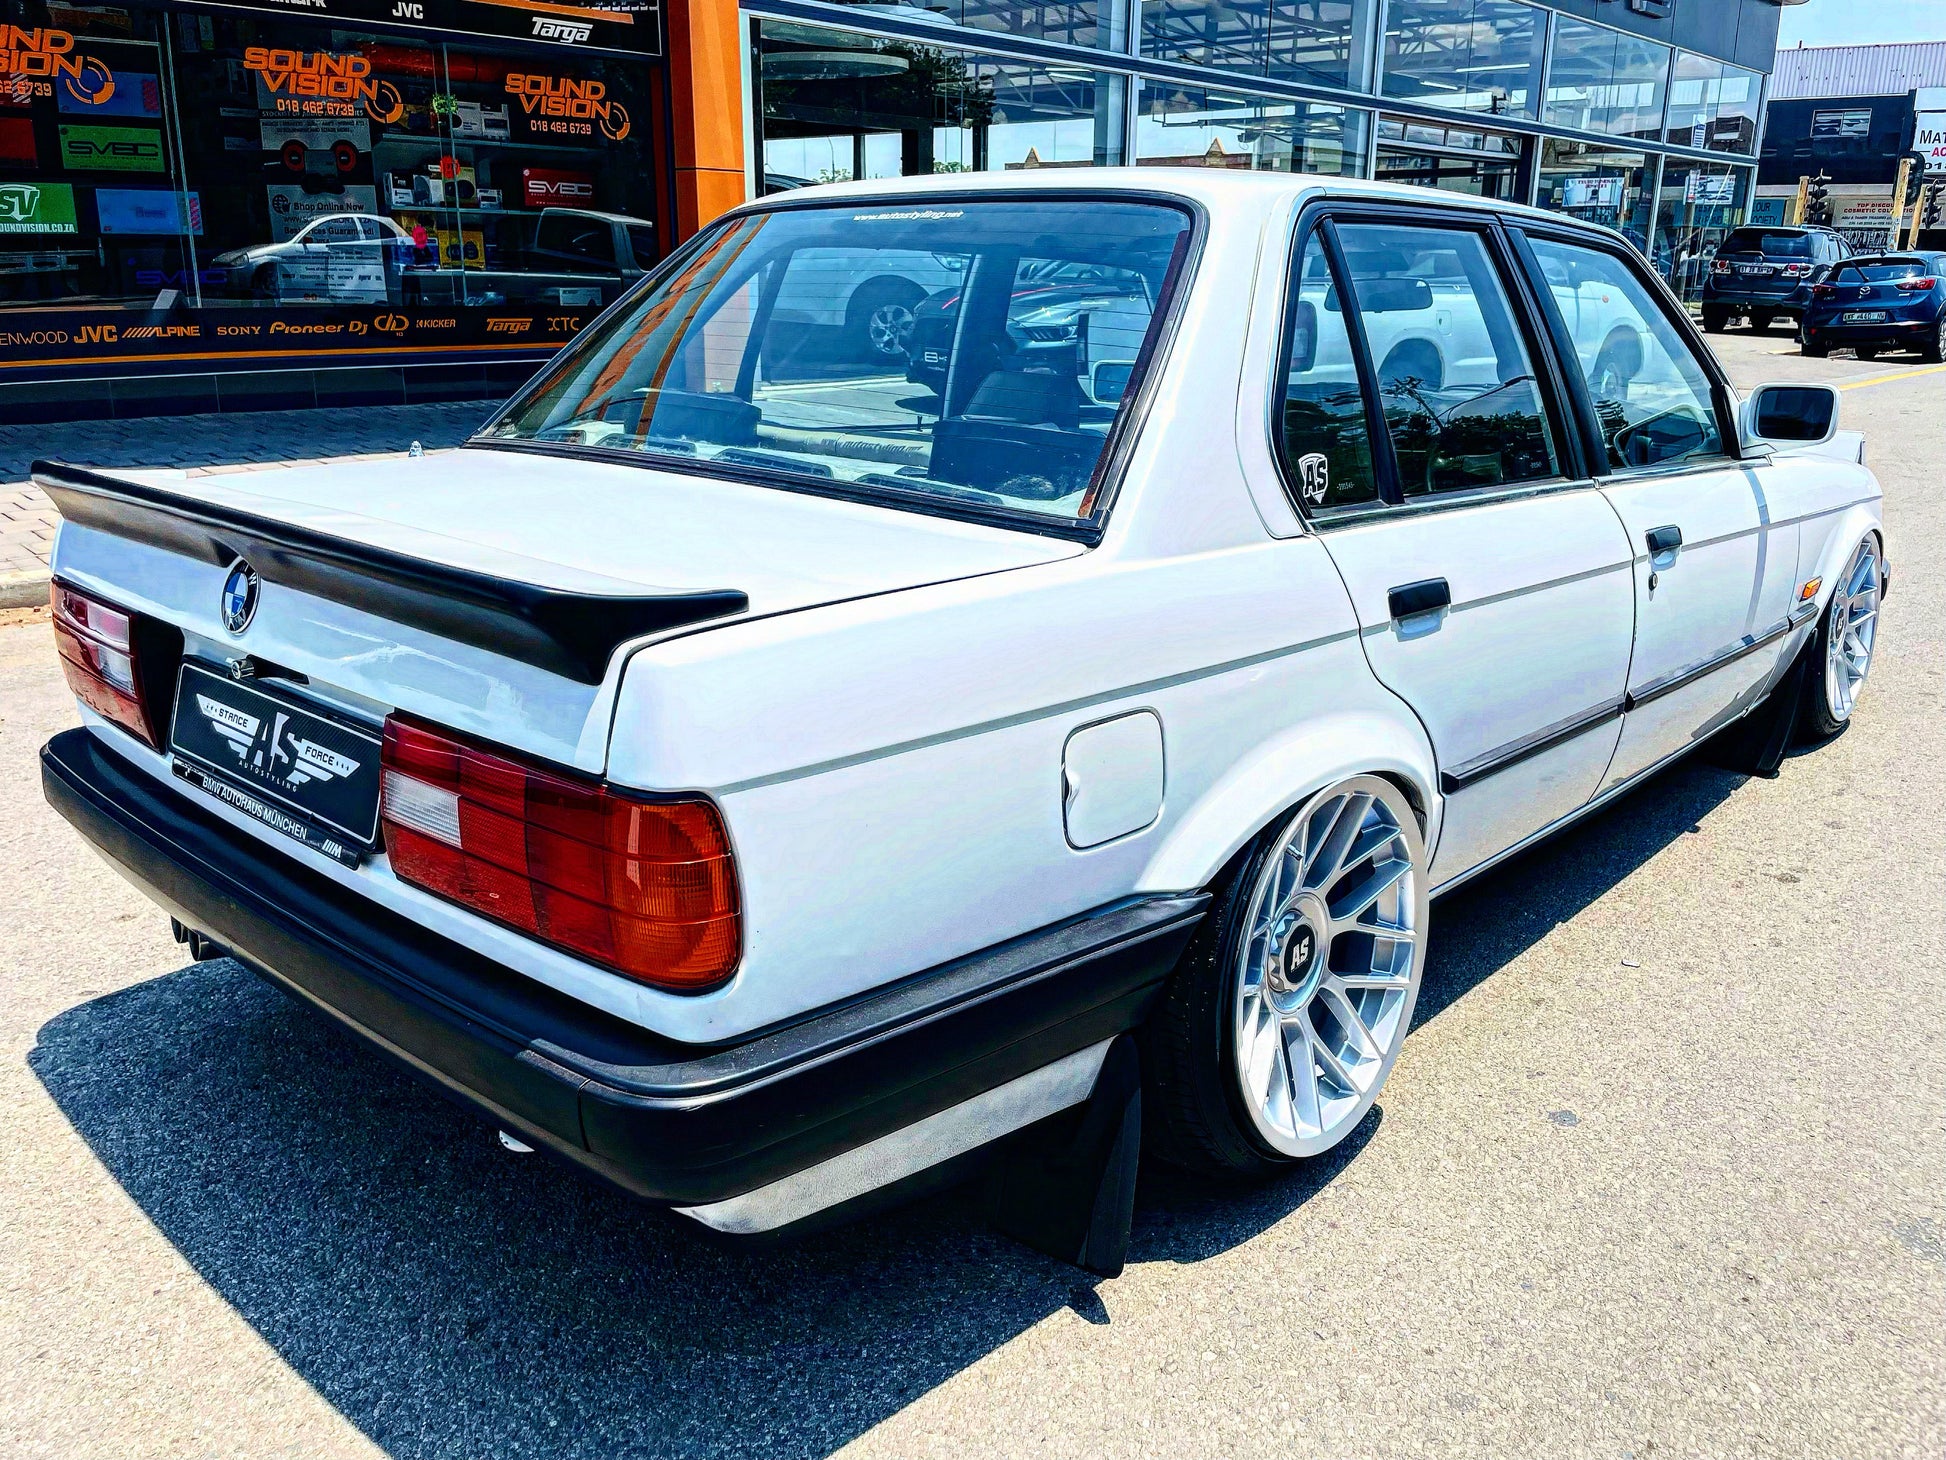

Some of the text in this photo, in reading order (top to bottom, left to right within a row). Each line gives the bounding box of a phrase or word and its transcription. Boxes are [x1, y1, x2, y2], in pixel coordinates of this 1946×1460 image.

[391, 1, 424, 20] JVC
[532, 16, 593, 43] Targa
[243, 47, 371, 79] SOUND
[259, 69, 379, 101] VISION
[505, 73, 606, 100] SOUND
[276, 99, 355, 116] 018 462 6739
[519, 94, 611, 120] VISION
[530, 120, 591, 135] 018 462 6739
[293, 203, 364, 212] Shop Online Now
[74, 325, 117, 343] JVC
[217, 326, 261, 336] SONY
[270, 321, 344, 334] Pioneer
[423, 318, 456, 328] KICKER
[486, 317, 533, 334] Targa
[1303, 458, 1328, 498] AS
[218, 708, 249, 728] STANCE
[304, 745, 335, 767] FORCE
[238, 759, 298, 793] AUTOSTYLING
[202, 776, 221, 795] BMW
[220, 784, 264, 819] AUTOHAUS
[262, 807, 308, 840] MÜNCHEN
[1290, 936, 1310, 973] AS
